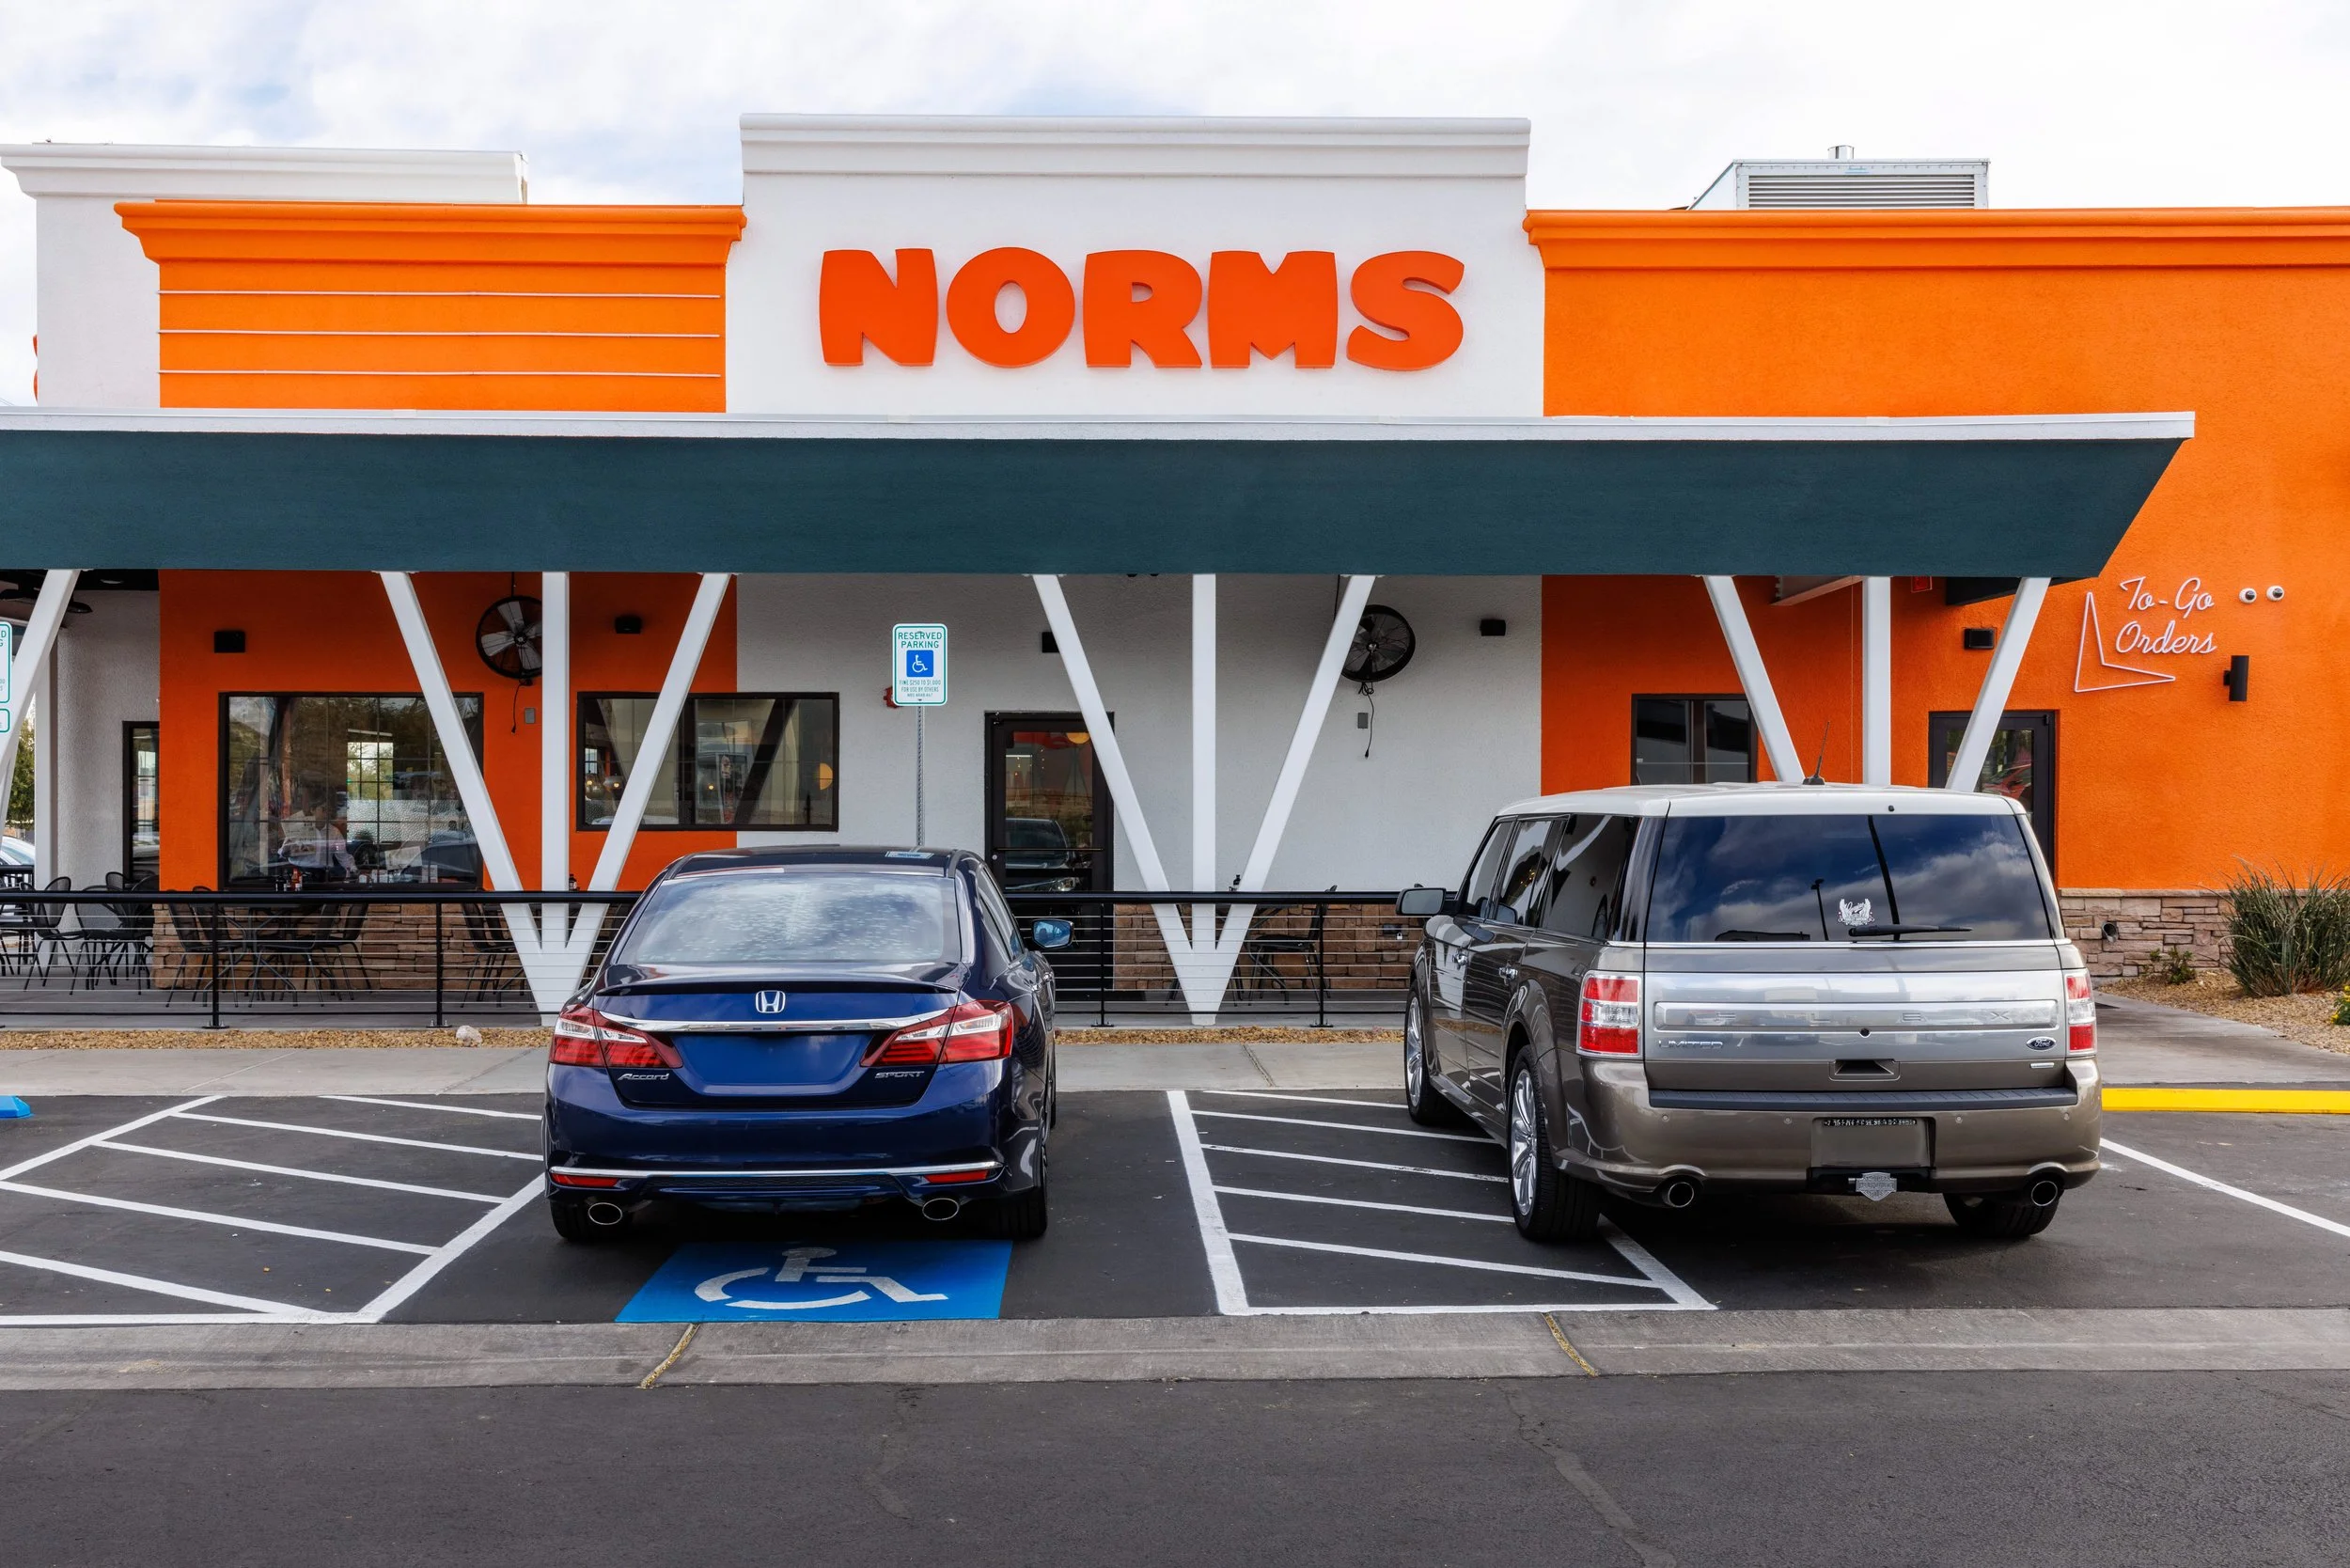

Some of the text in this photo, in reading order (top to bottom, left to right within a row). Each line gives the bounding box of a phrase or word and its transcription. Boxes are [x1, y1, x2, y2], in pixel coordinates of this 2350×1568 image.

[819, 246, 1465, 371] NORMS
[2119, 575, 2216, 619] To-Go
[898, 632, 943, 640] RESERVED
[2115, 619, 2217, 655] Orders
[901, 640, 939, 649] PARKING
[617, 1073, 670, 1081] Accord
[874, 1071, 925, 1079] SPORT
